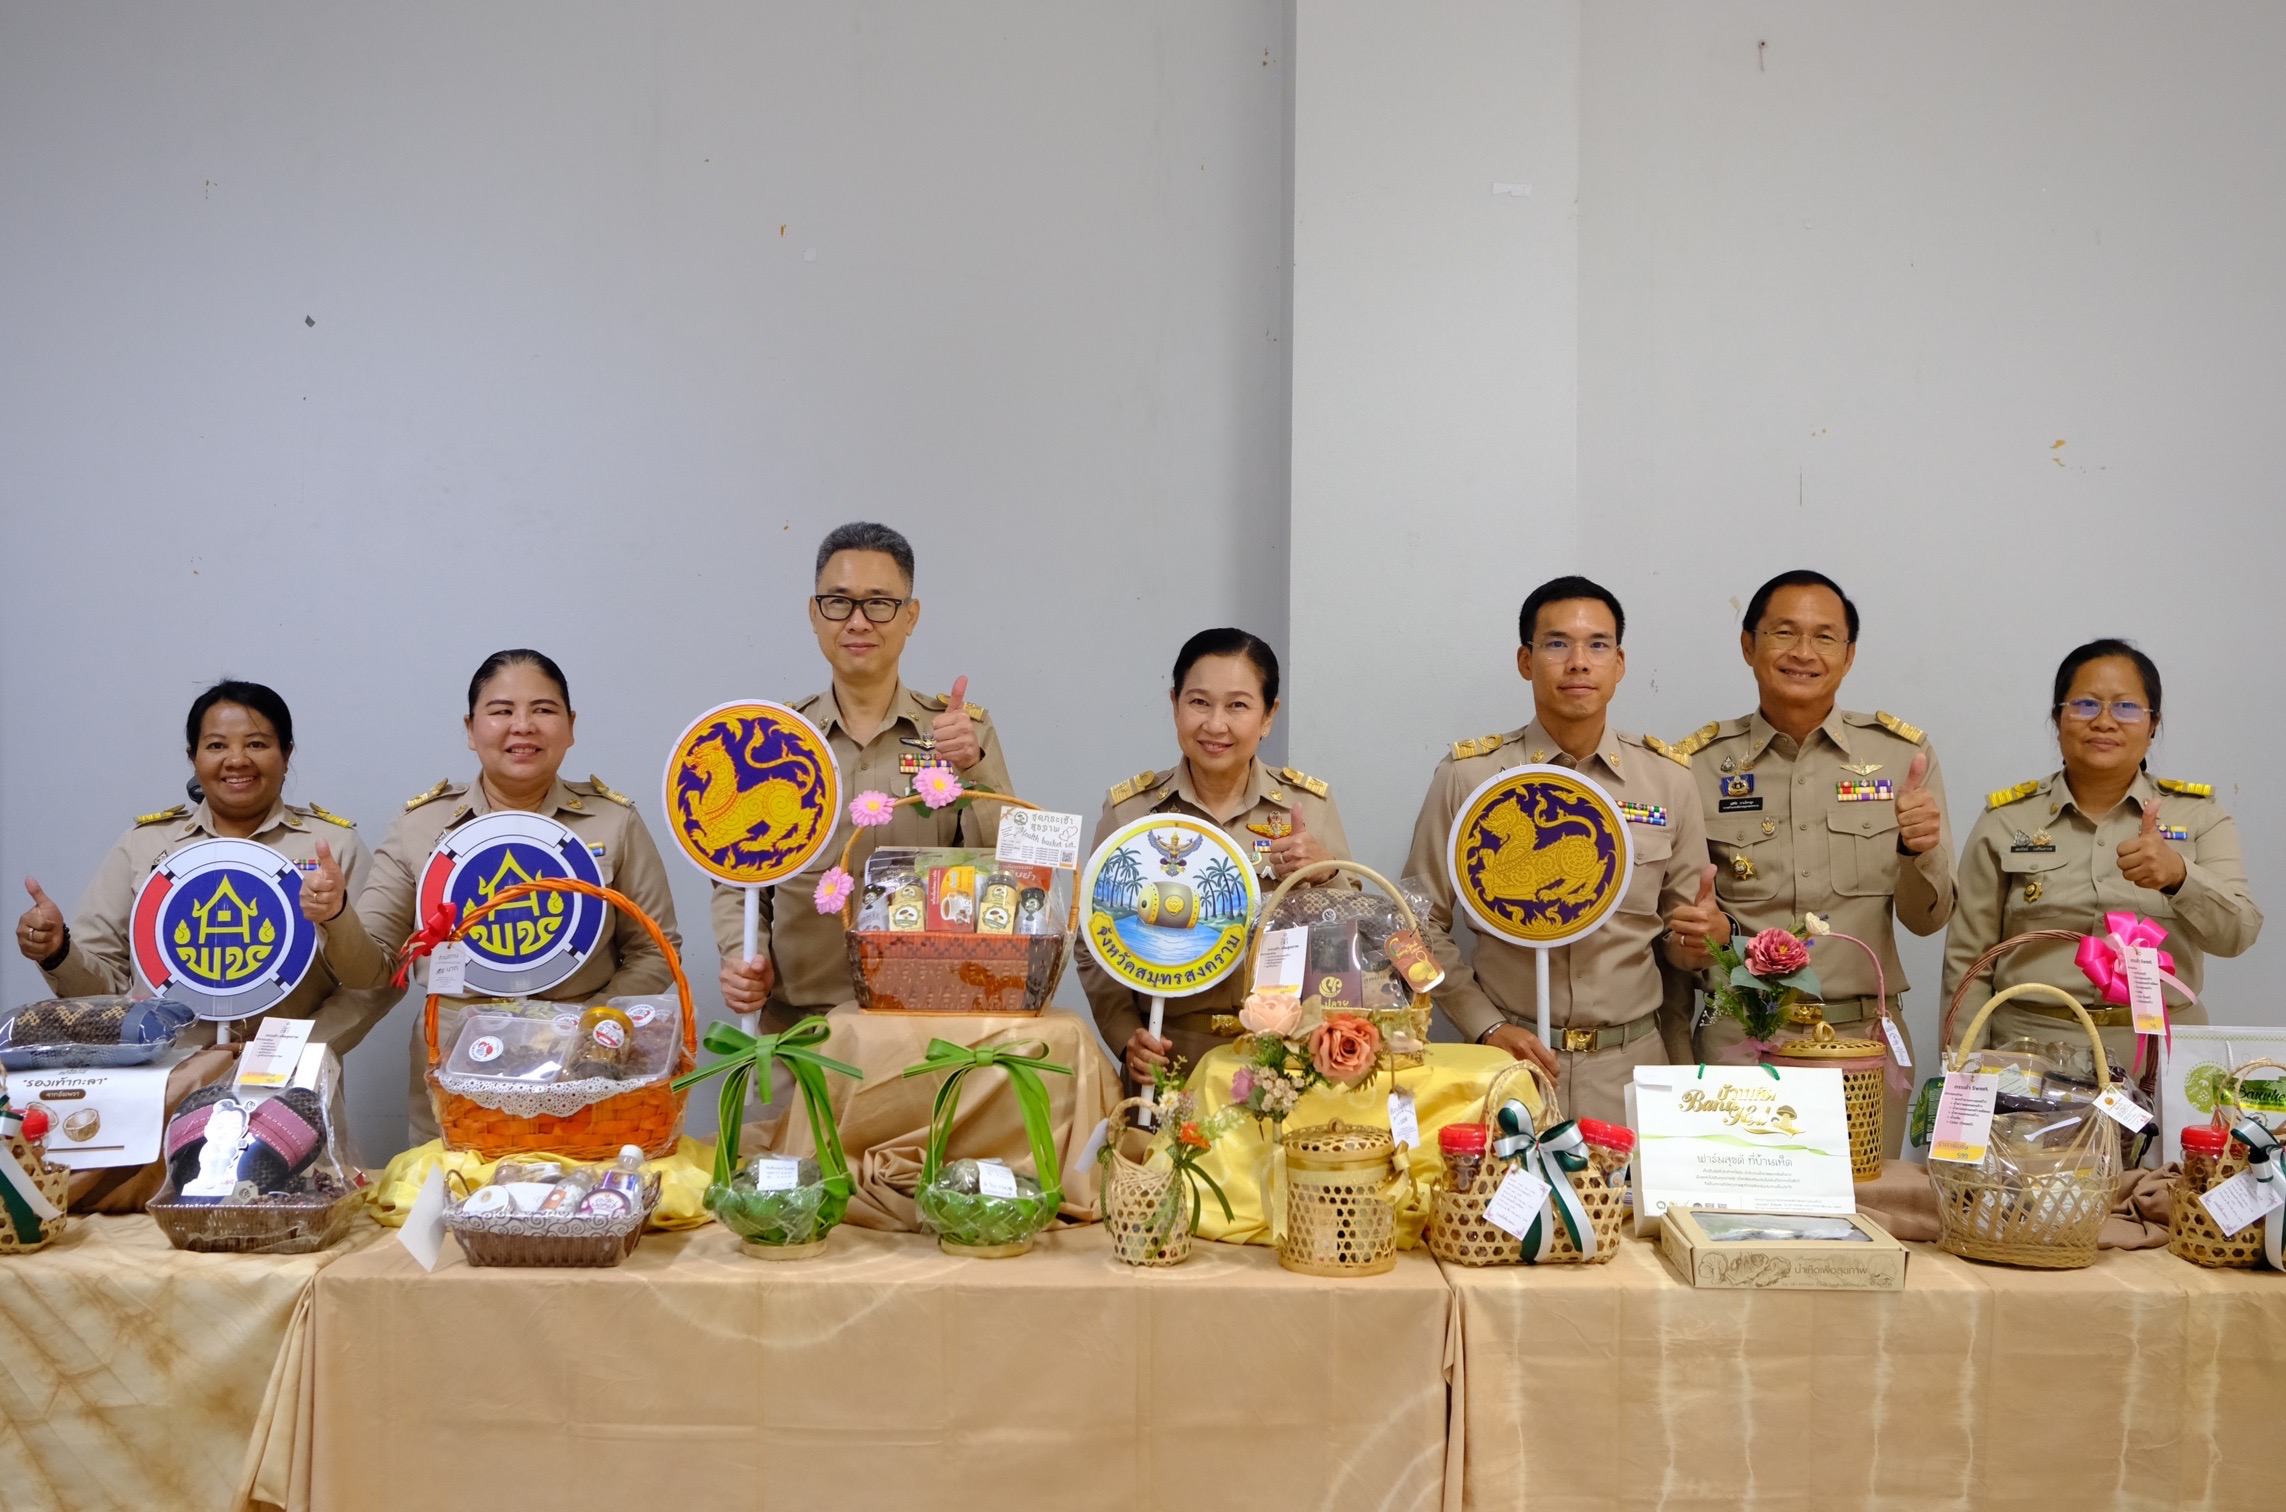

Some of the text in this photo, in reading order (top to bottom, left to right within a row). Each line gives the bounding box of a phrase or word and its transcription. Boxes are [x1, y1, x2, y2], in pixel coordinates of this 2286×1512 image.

[1013, 826, 1040, 843] Health
[1041, 837, 1062, 848] basket
[1096, 925, 1241, 988] จังหวัดสมุทรสงคราม
